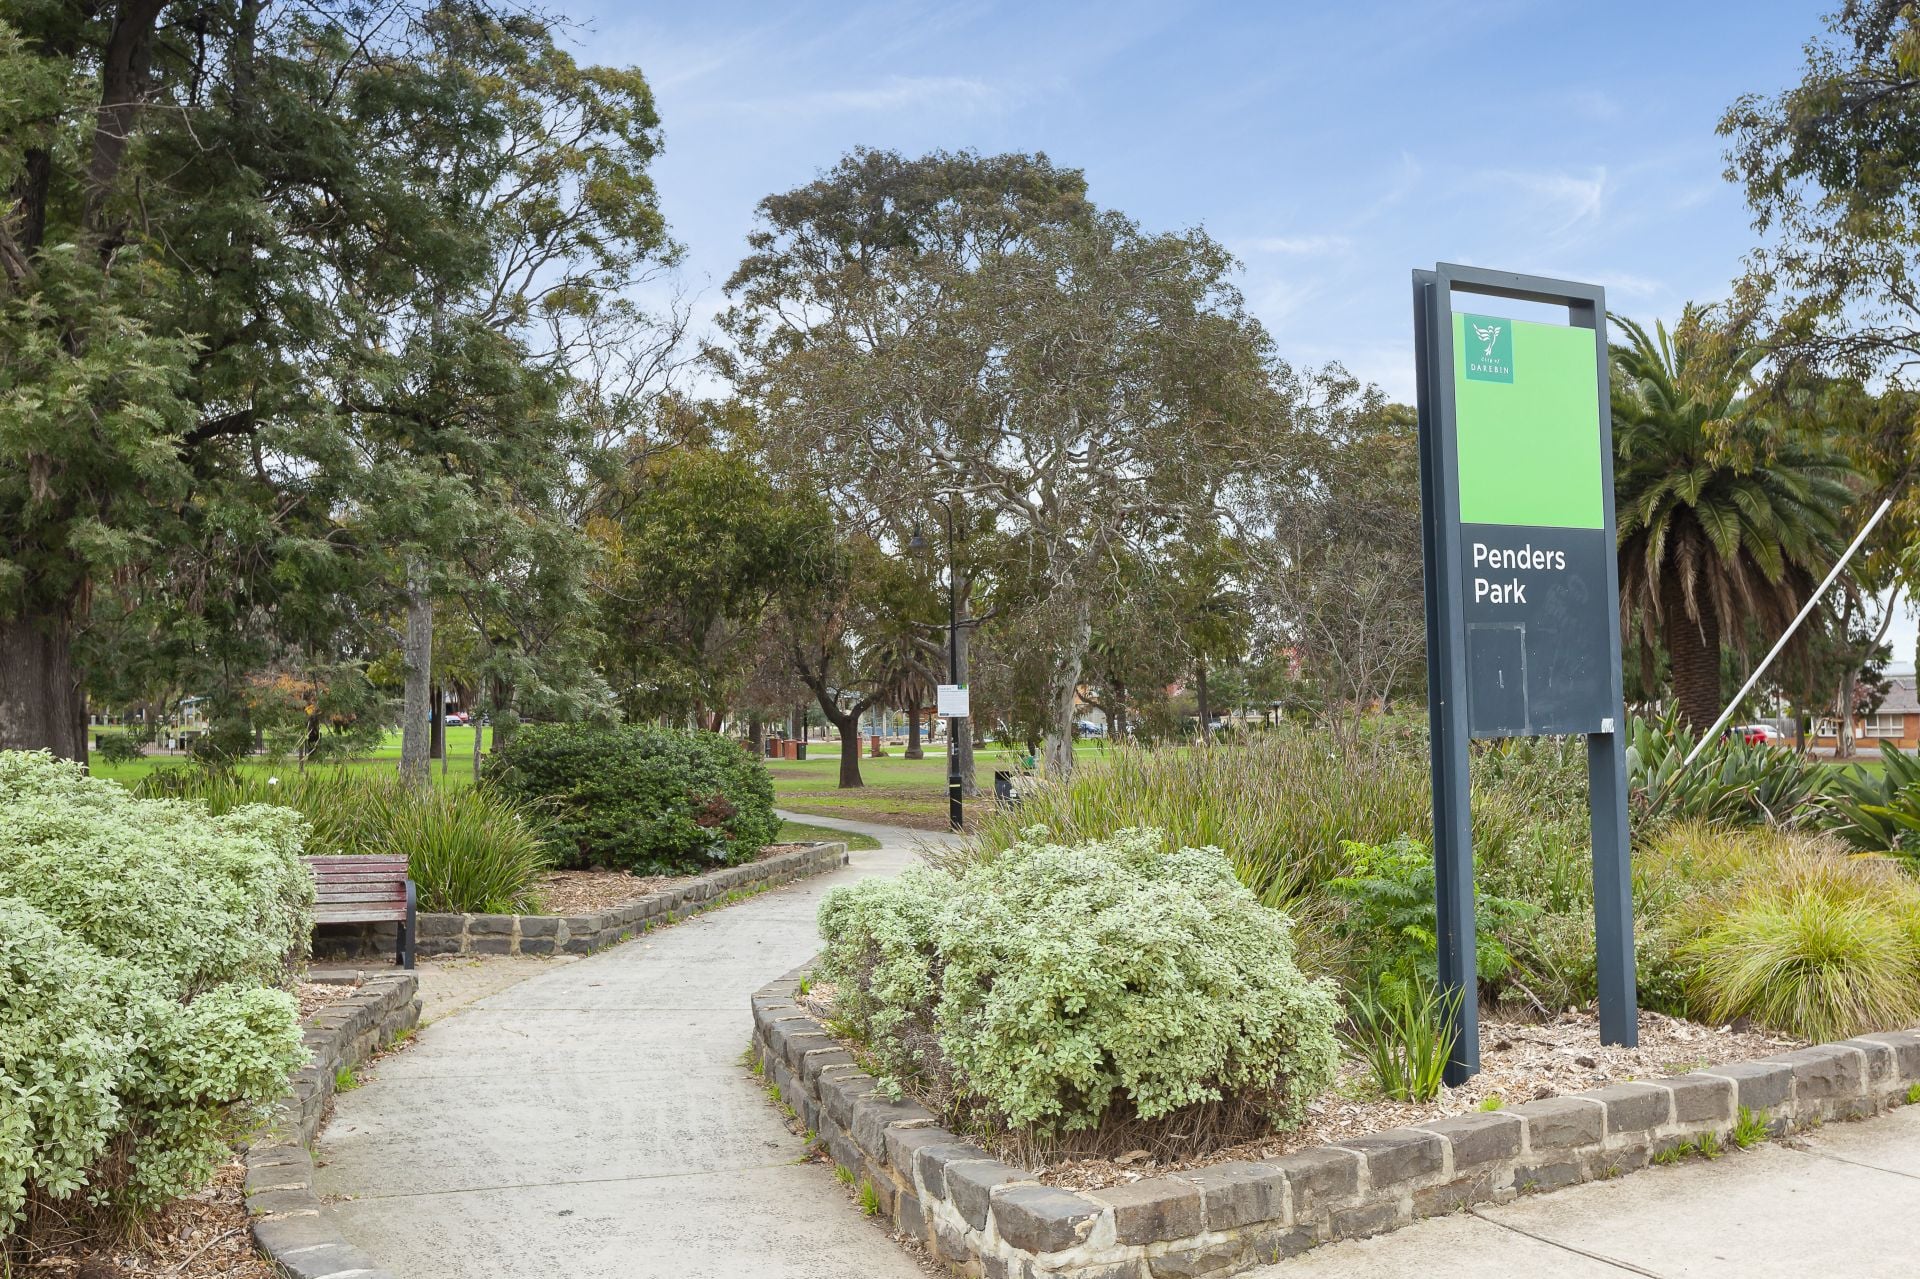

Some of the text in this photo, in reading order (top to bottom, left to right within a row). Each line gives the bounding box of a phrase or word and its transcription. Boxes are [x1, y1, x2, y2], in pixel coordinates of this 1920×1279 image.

[1470, 363, 1509, 374] DAREBIN
[1473, 543, 1566, 570] Penders
[1474, 578, 1527, 604] Park
